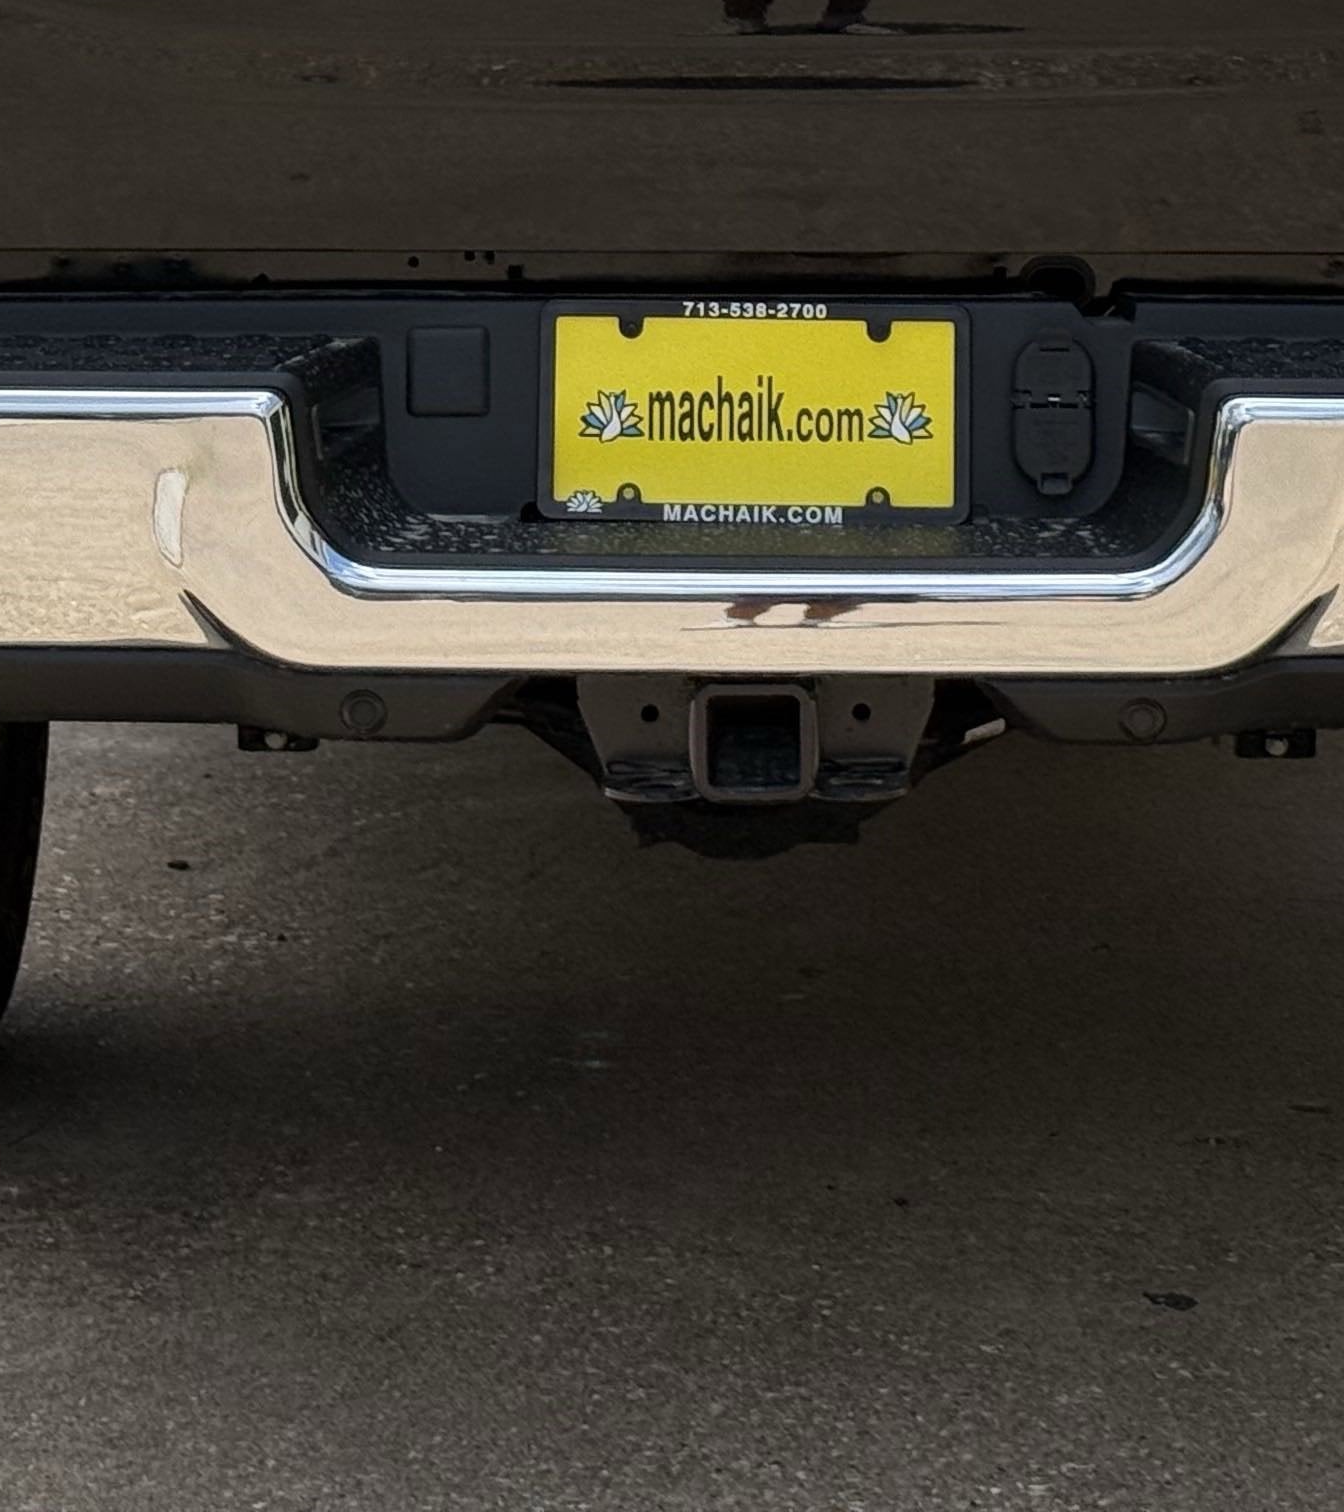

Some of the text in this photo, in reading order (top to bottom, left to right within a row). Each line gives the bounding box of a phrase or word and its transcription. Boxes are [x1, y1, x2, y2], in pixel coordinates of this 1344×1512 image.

[682, 301, 828, 320] 713-538-2700
[648, 375, 864, 442] machaik.com
[662, 504, 843, 525] MACHAIK.COM
